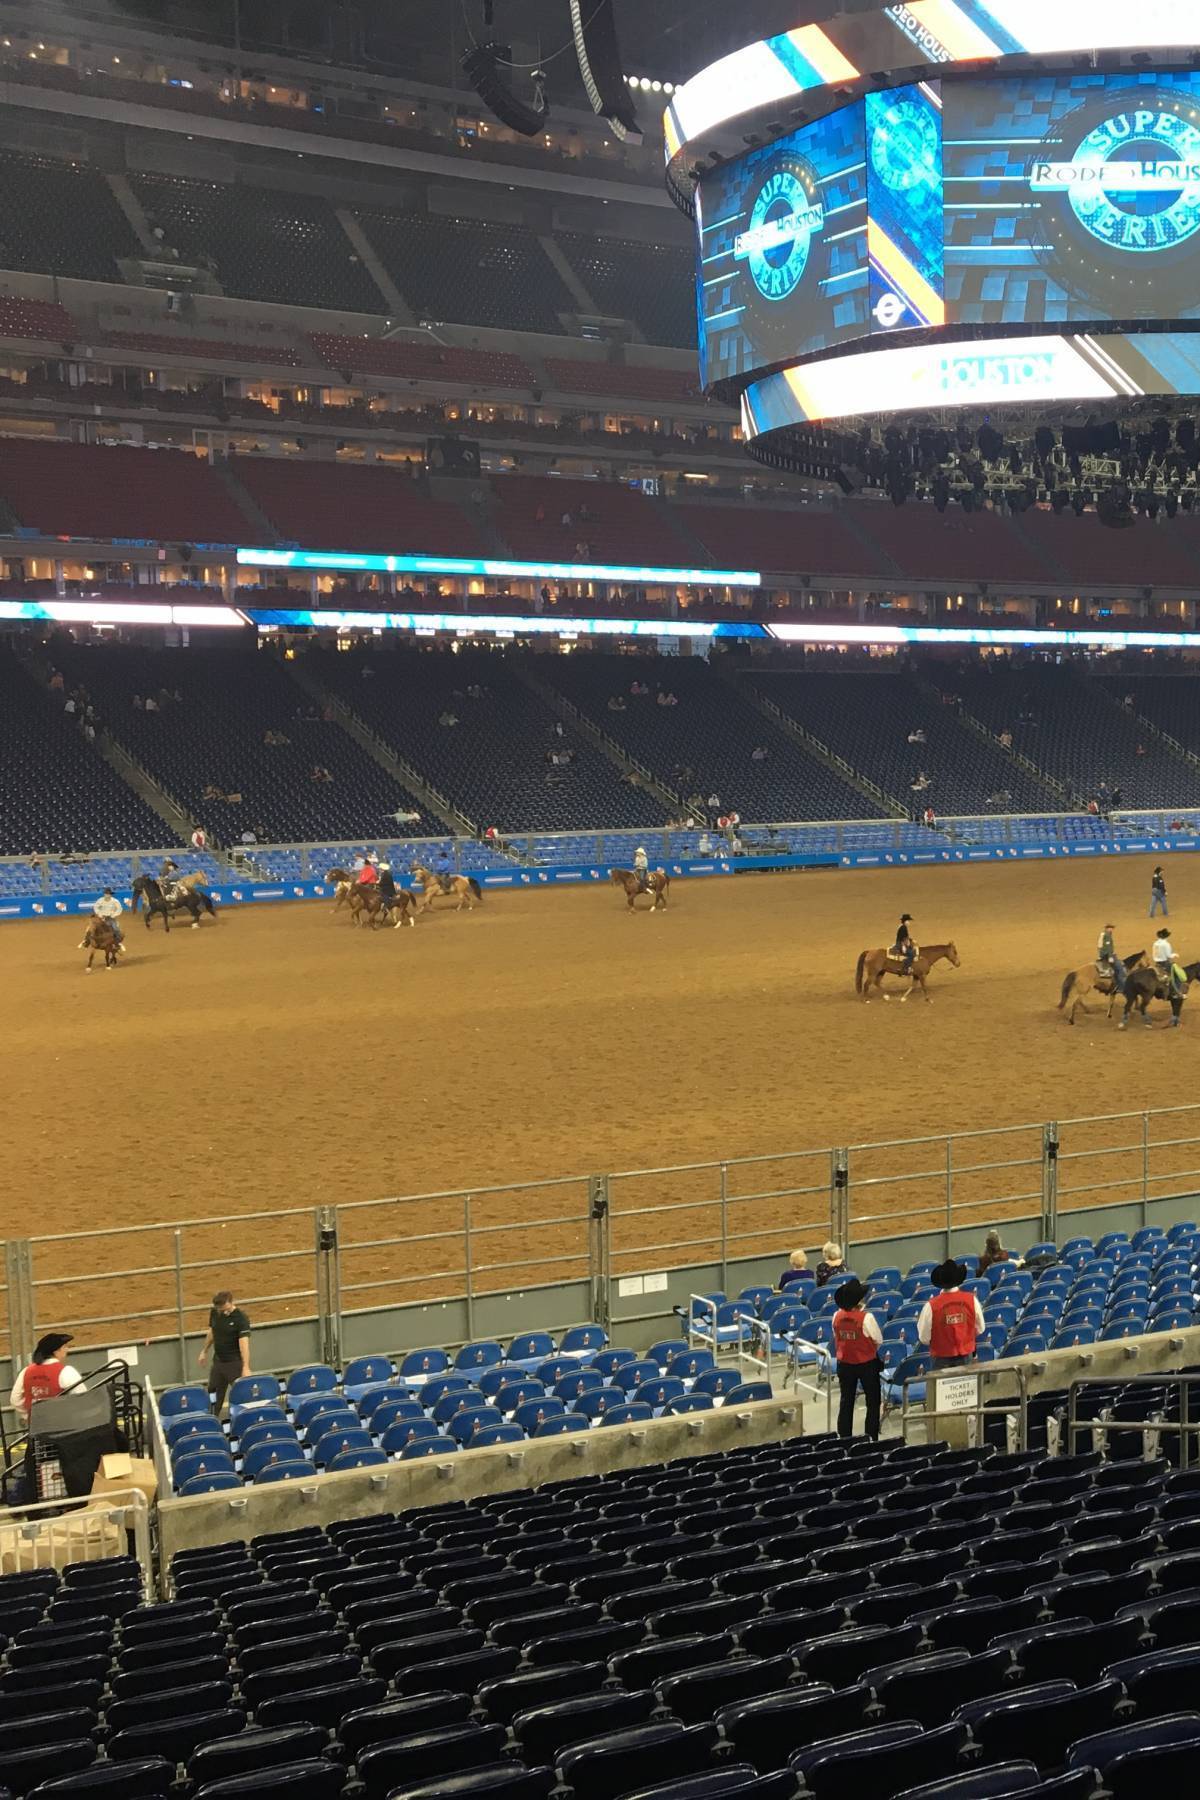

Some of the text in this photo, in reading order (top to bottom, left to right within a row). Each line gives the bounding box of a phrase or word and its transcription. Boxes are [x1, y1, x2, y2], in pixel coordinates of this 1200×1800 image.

[755, 172, 807, 216] SUPER
[949, 1382, 970, 1391] TICKET
[944, 1390, 975, 1401] HOLDERS
[951, 1399, 968, 1407] ONLY
